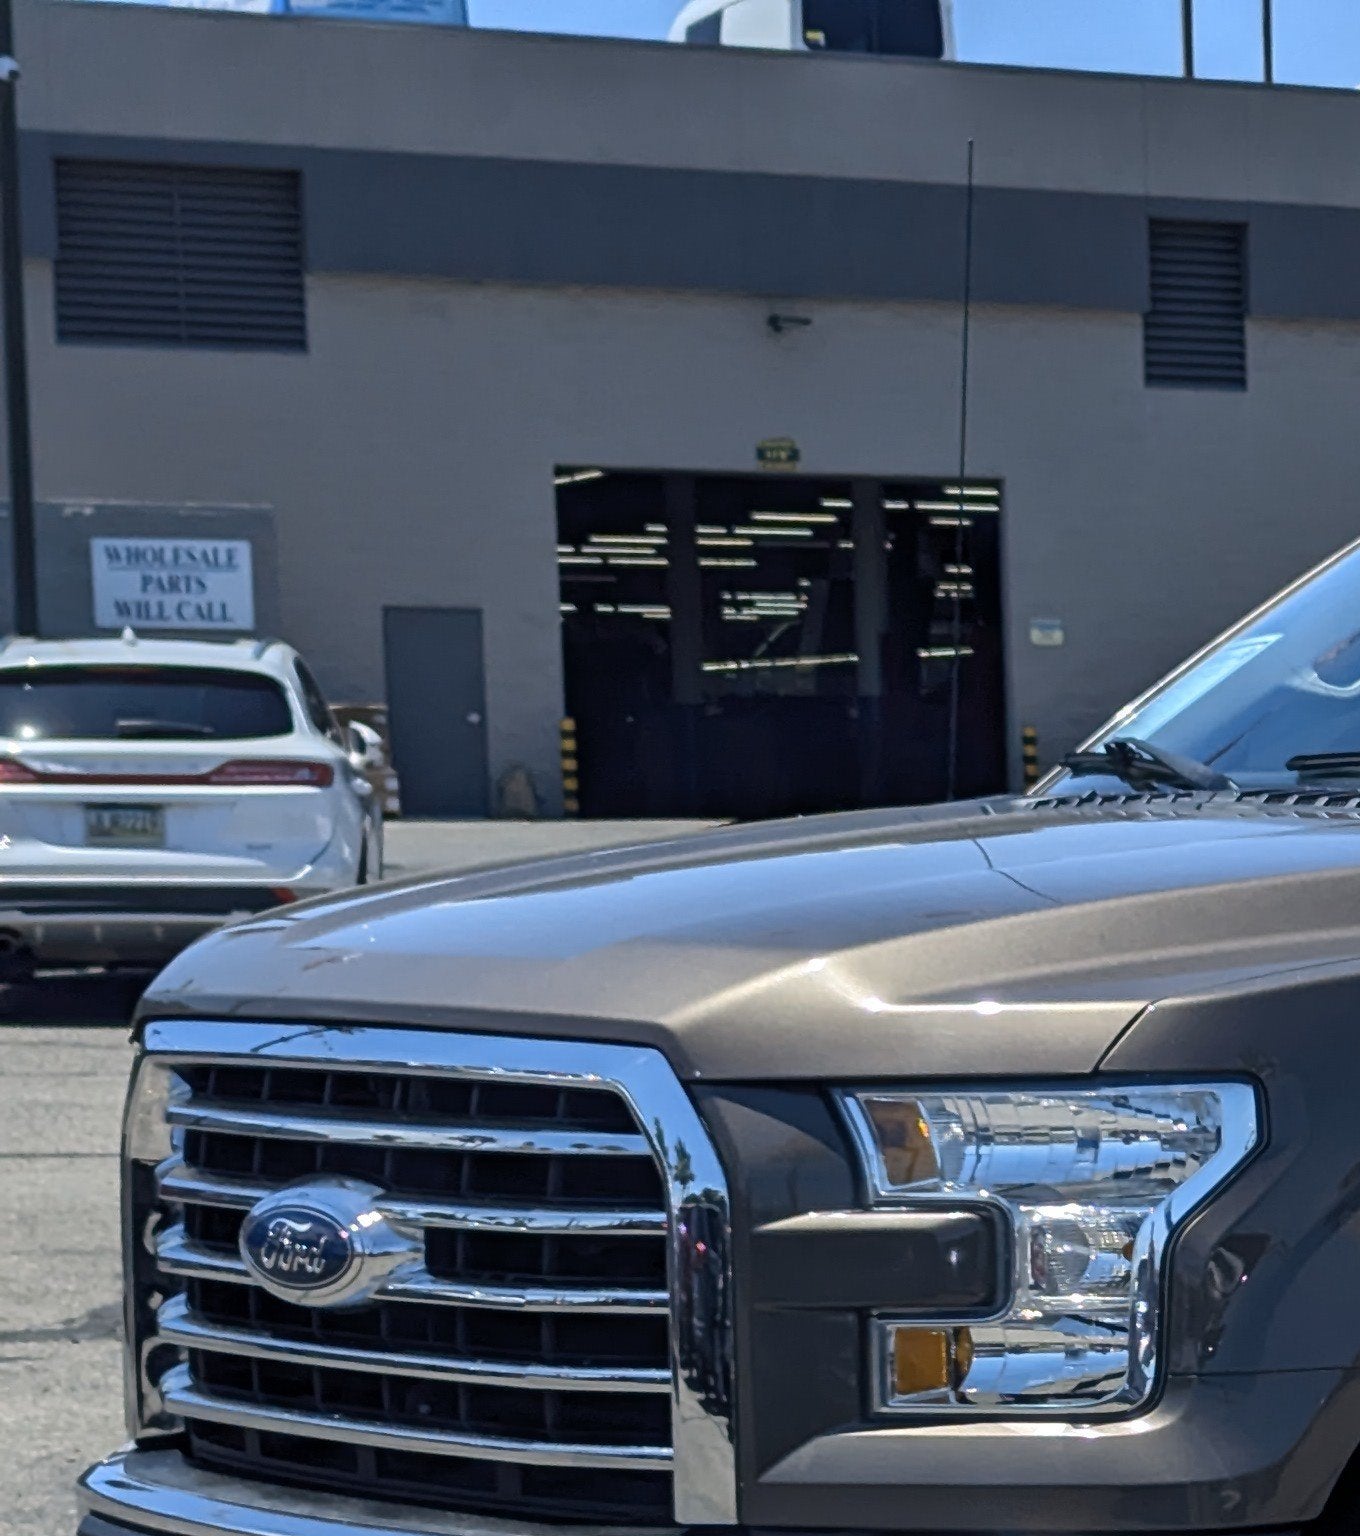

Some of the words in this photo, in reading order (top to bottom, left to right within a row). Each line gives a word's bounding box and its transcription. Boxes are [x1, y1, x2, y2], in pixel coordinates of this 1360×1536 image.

[104, 545, 240, 569] WHOLESALE
[140, 573, 207, 595] PARTS
[113, 600, 170, 622] WILL
[176, 601, 234, 624] CALL
[260, 1217, 328, 1275] Ford
